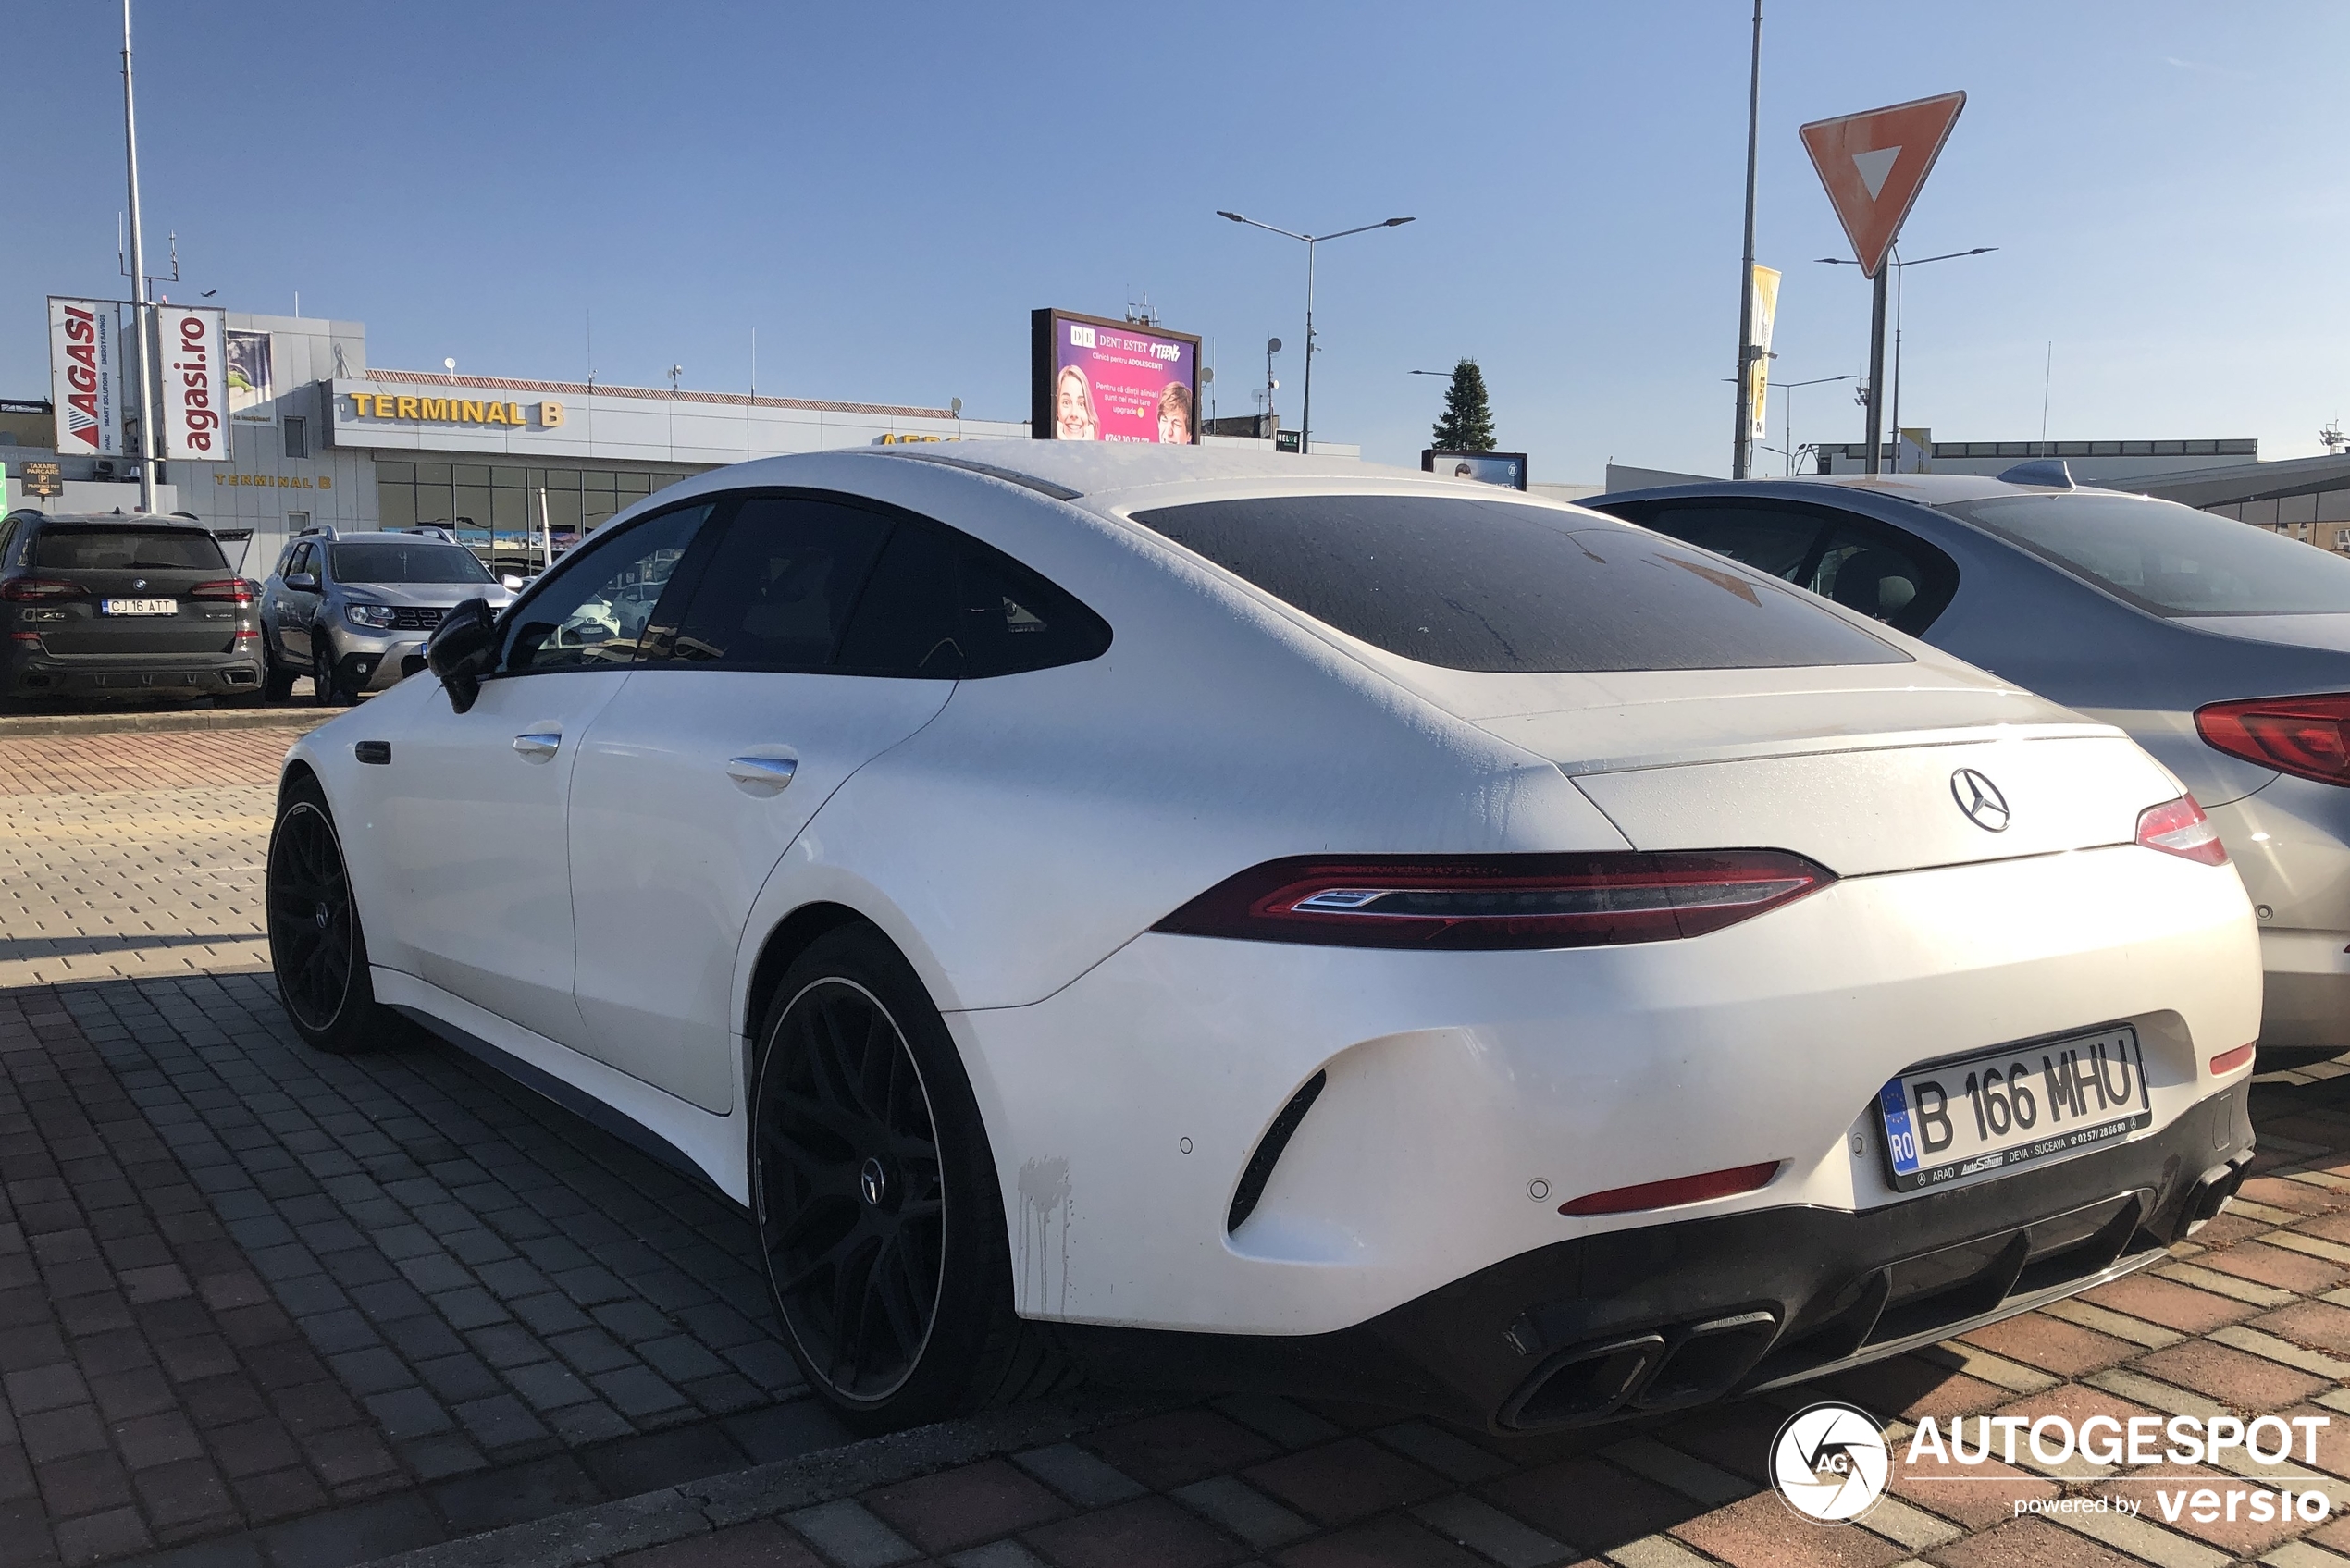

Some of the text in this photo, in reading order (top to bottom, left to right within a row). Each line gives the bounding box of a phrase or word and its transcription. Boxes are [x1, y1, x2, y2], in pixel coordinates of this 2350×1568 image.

[1099, 335, 1122, 349] DENT
[1123, 339, 1148, 353] ESTET
[64, 305, 98, 419] AGASI
[1092, 352, 1110, 362] Clinică
[1110, 356, 1128, 364] pentru
[173, 317, 219, 451] agasi.ro
[1095, 381, 1116, 392] Pentru
[1117, 385, 1123, 393] că
[1140, 389, 1159, 400] aliniați
[350, 392, 565, 427] TERMINAL B
[1104, 393, 1118, 401] sunt
[1127, 397, 1139, 405] mai
[1139, 398, 1151, 407] tare
[1112, 406, 1137, 415] upgrade
[214, 474, 332, 489] TERMINAL B
[111, 600, 170, 611] CJ 16 ATT
[1912, 1039, 2132, 1155] B 166 MHU
[1891, 1130, 1914, 1163] RO
[1932, 1167, 1955, 1182] ARAD
[1961, 1153, 2003, 1175] AutoSchunn
[2009, 1149, 2029, 1162] DEVA
[2035, 1140, 2066, 1156] SUCEAVA
